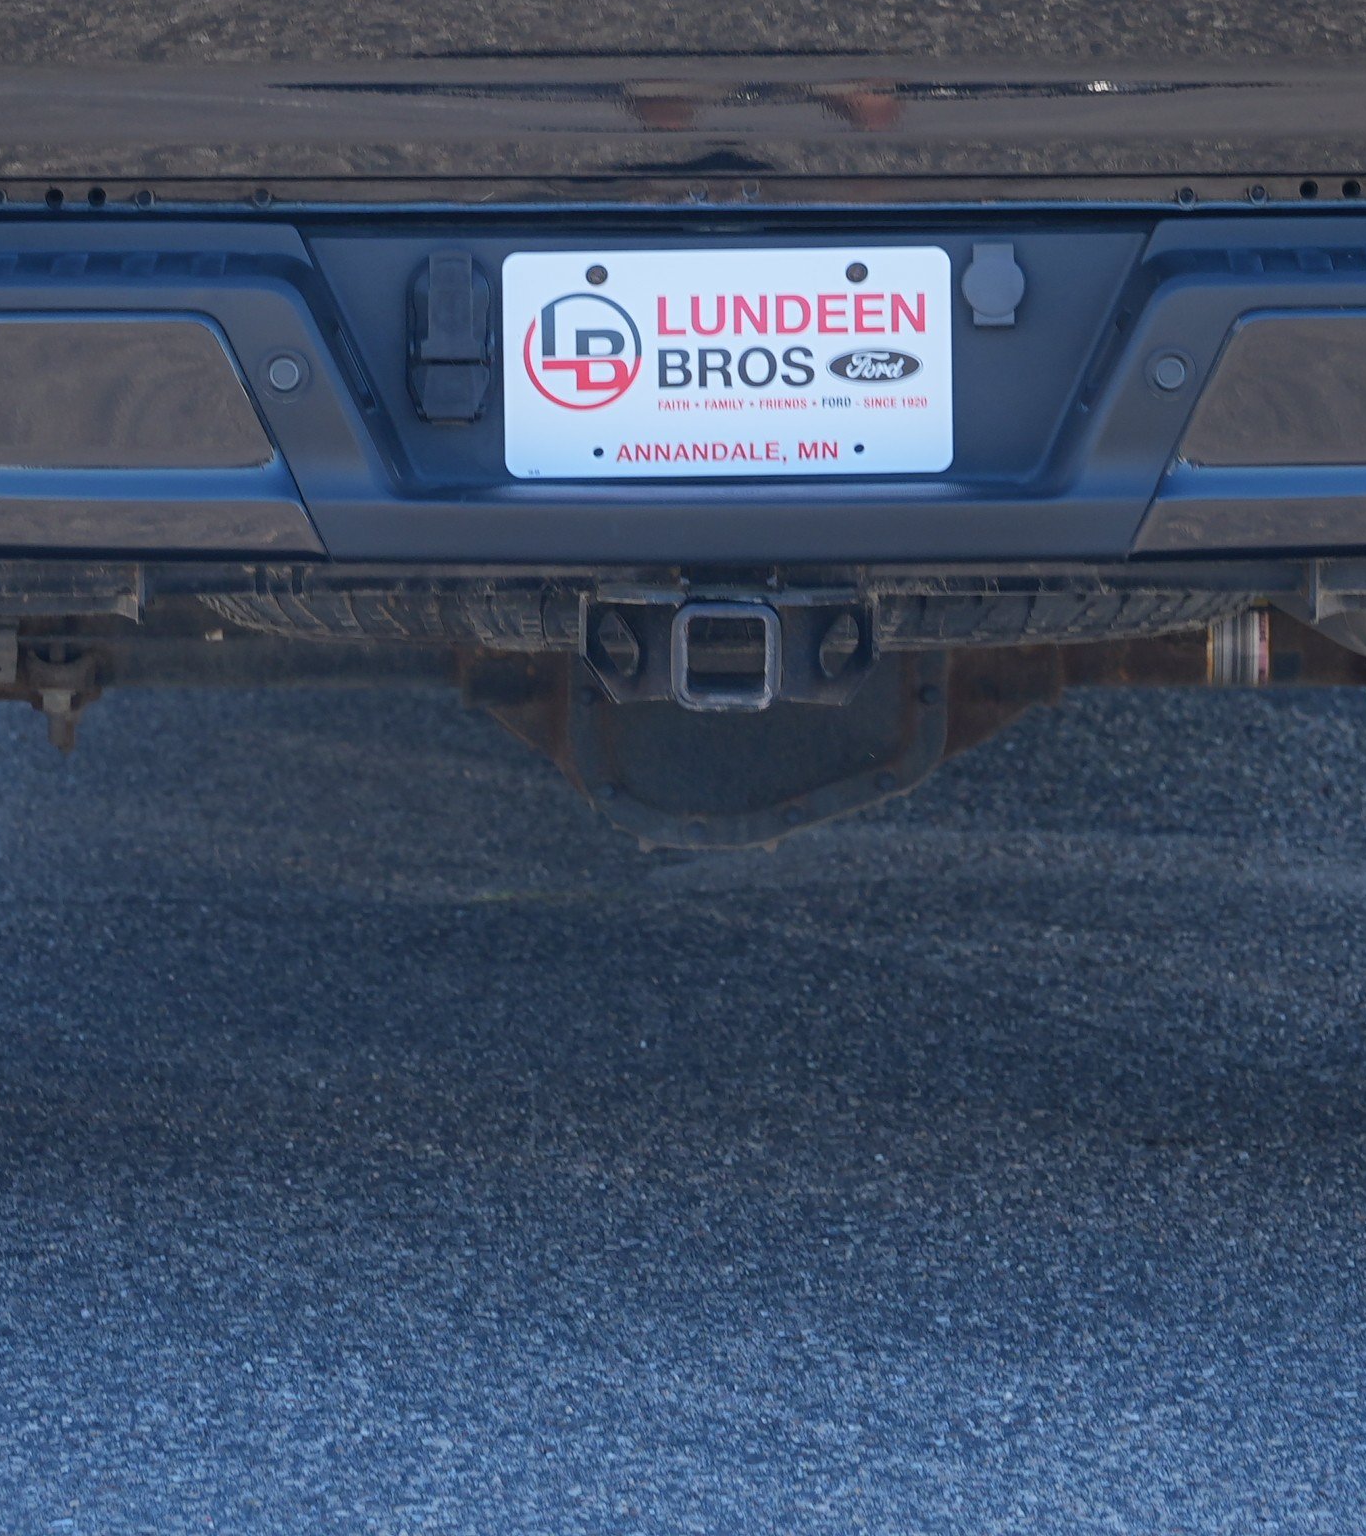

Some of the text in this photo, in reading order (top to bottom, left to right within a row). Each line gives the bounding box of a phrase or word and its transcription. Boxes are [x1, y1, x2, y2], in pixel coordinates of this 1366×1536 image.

[657, 293, 927, 337] LUNDEEN
[658, 346, 816, 389] BROS
[658, 397, 928, 411] FAITH FAMILY FRIENDS FORD SINCE 1920
[616, 441, 839, 463] ANNANDALE, MN
